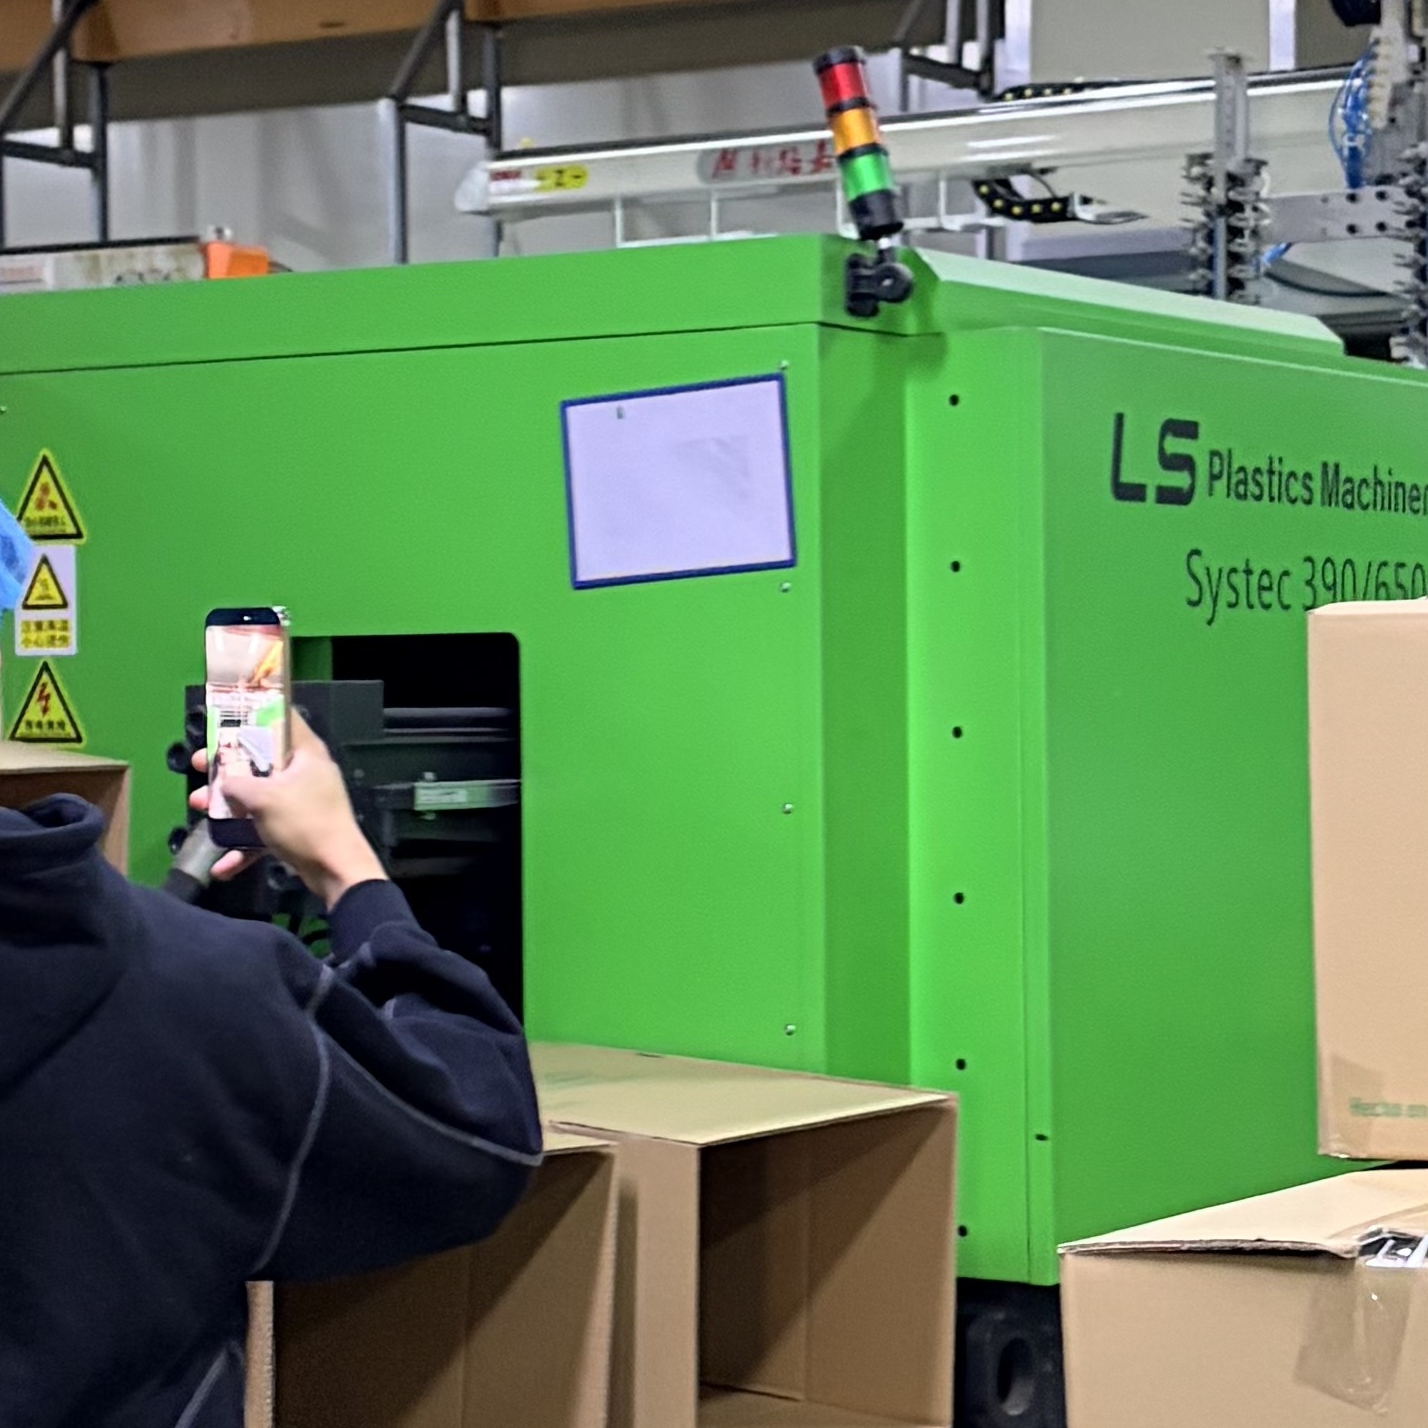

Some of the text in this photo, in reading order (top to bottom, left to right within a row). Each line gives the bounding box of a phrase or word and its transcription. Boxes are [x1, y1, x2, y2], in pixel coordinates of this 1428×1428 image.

[1110, 412, 1200, 506] LS
[1207, 447, 1314, 507] Plastics
[1186, 548, 1292, 626] Systec
